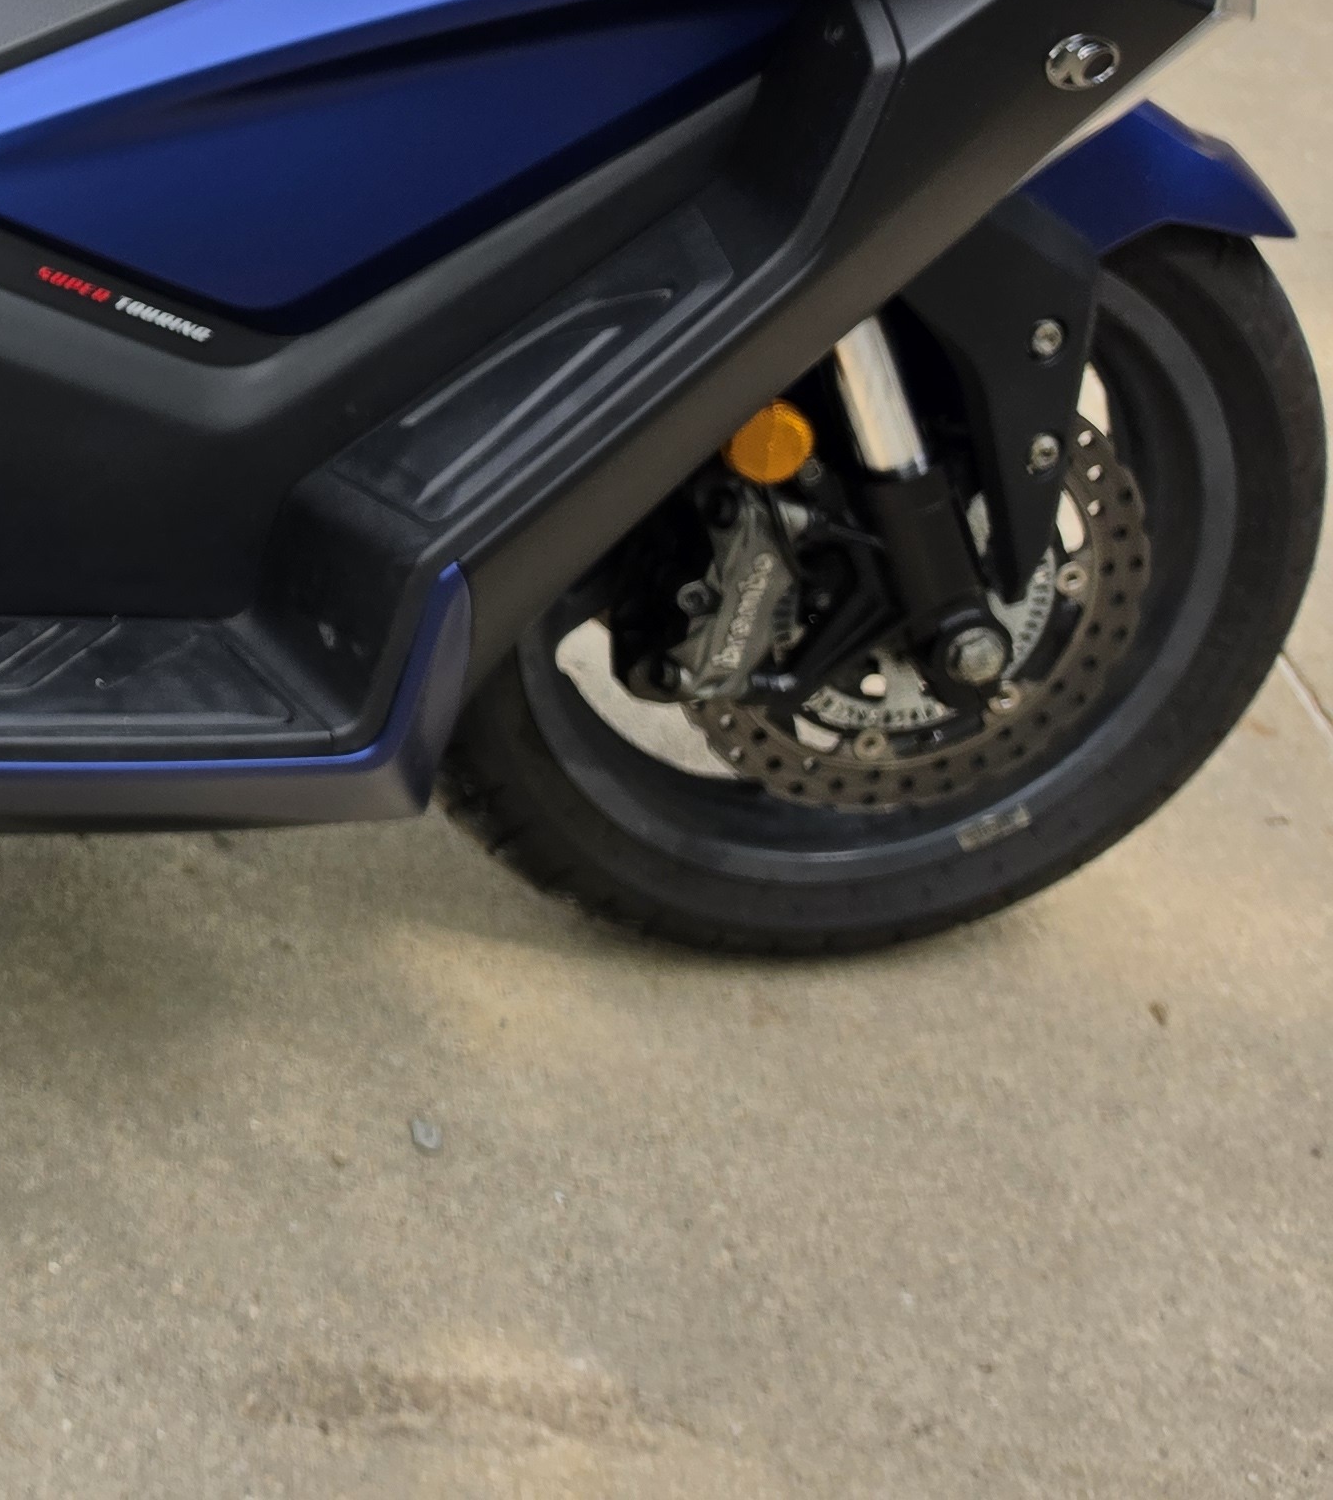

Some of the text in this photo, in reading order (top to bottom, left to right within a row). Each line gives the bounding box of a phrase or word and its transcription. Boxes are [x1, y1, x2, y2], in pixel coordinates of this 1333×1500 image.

[37, 266, 214, 342] SUPER TOURING
[711, 552, 773, 669] brembo
